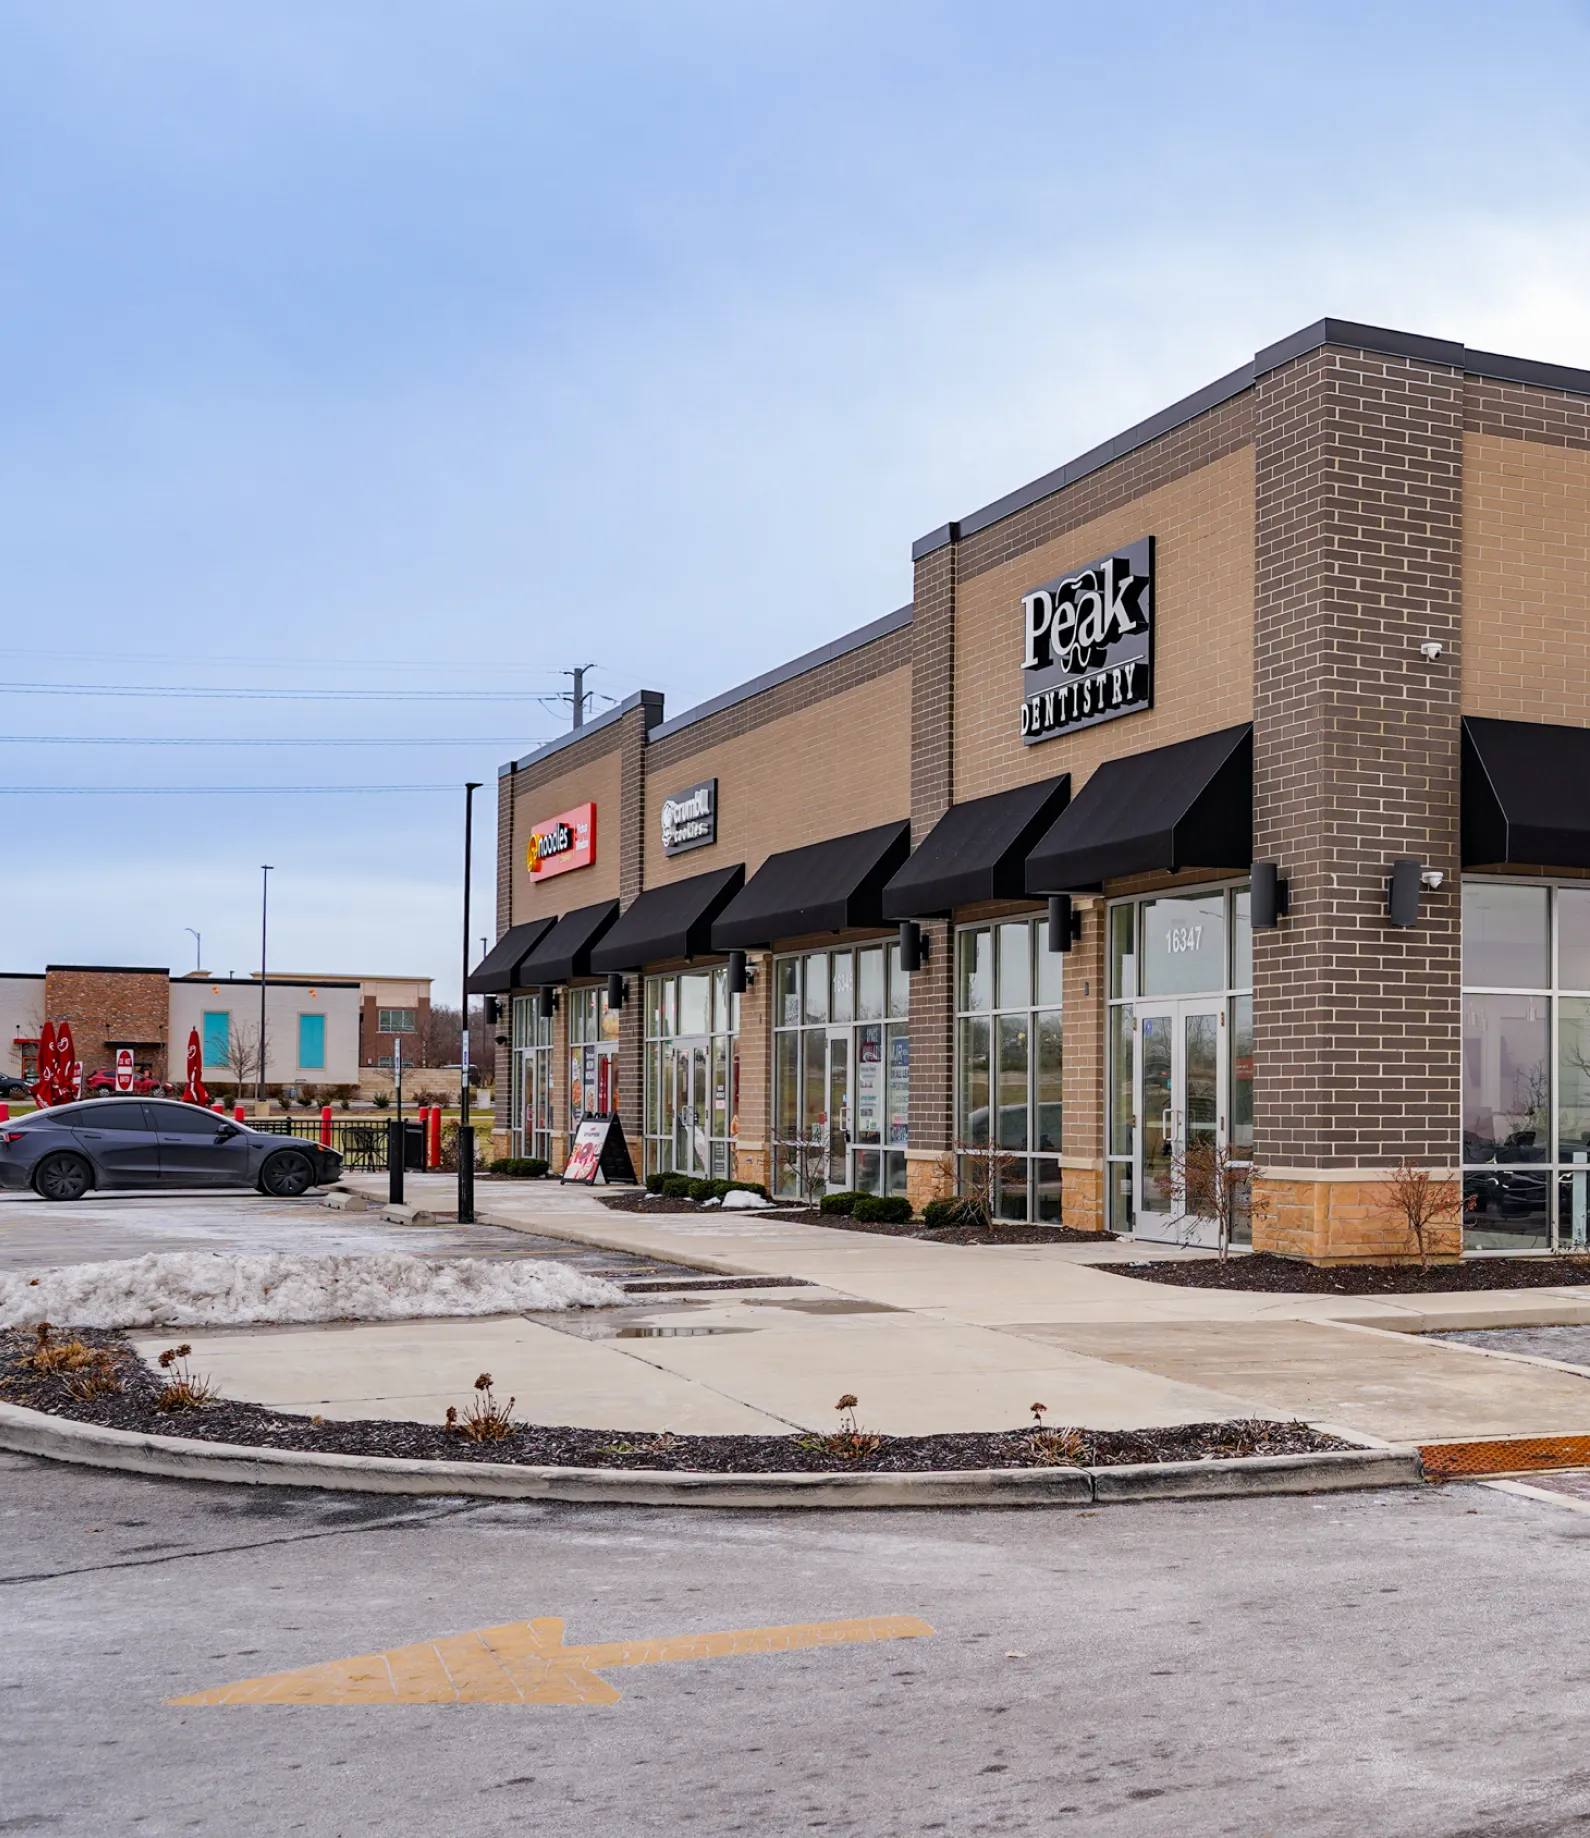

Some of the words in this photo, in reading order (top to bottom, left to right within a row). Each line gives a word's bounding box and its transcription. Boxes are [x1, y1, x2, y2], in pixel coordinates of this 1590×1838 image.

[1020, 557, 1137, 670] Peak
[1020, 662, 1136, 736] DENTISTRY
[538, 823, 568, 857] noodles
[1165, 925, 1202, 954] 16347
